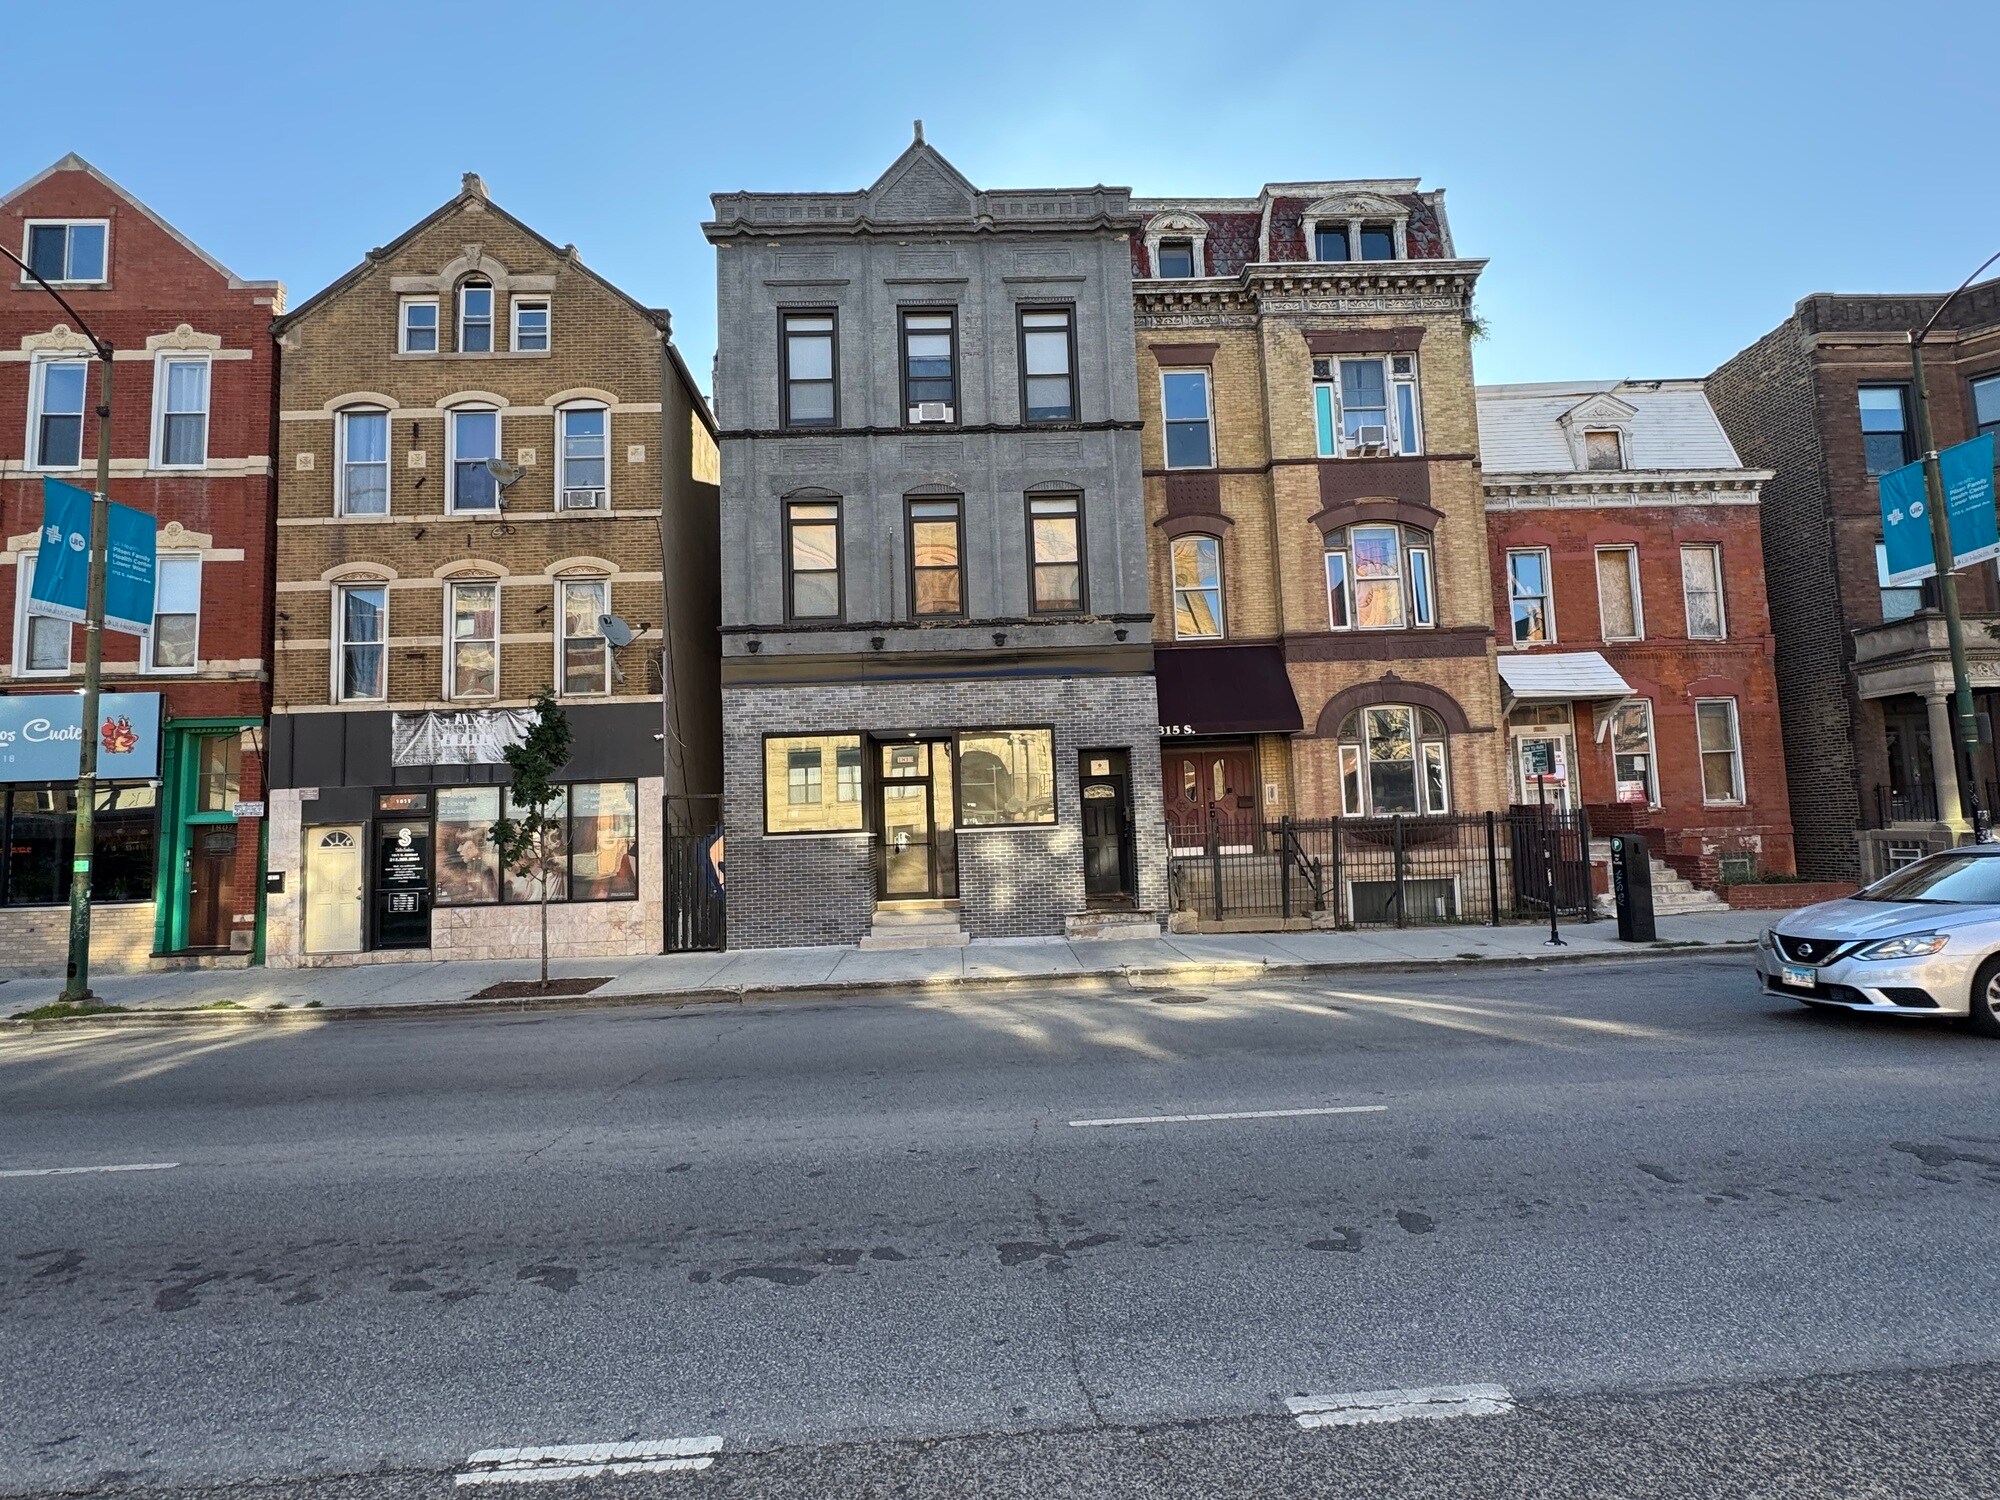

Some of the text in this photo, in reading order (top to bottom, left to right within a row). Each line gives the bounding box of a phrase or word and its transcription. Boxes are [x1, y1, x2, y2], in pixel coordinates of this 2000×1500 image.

[1910, 505, 1922, 515] UIC
[71, 539, 84, 547] UIC
[23, 718, 83, 742] Cuate
[1183, 724, 1196, 735] S.
[3, 754, 15, 763] 18
[398, 828, 412, 847] S
